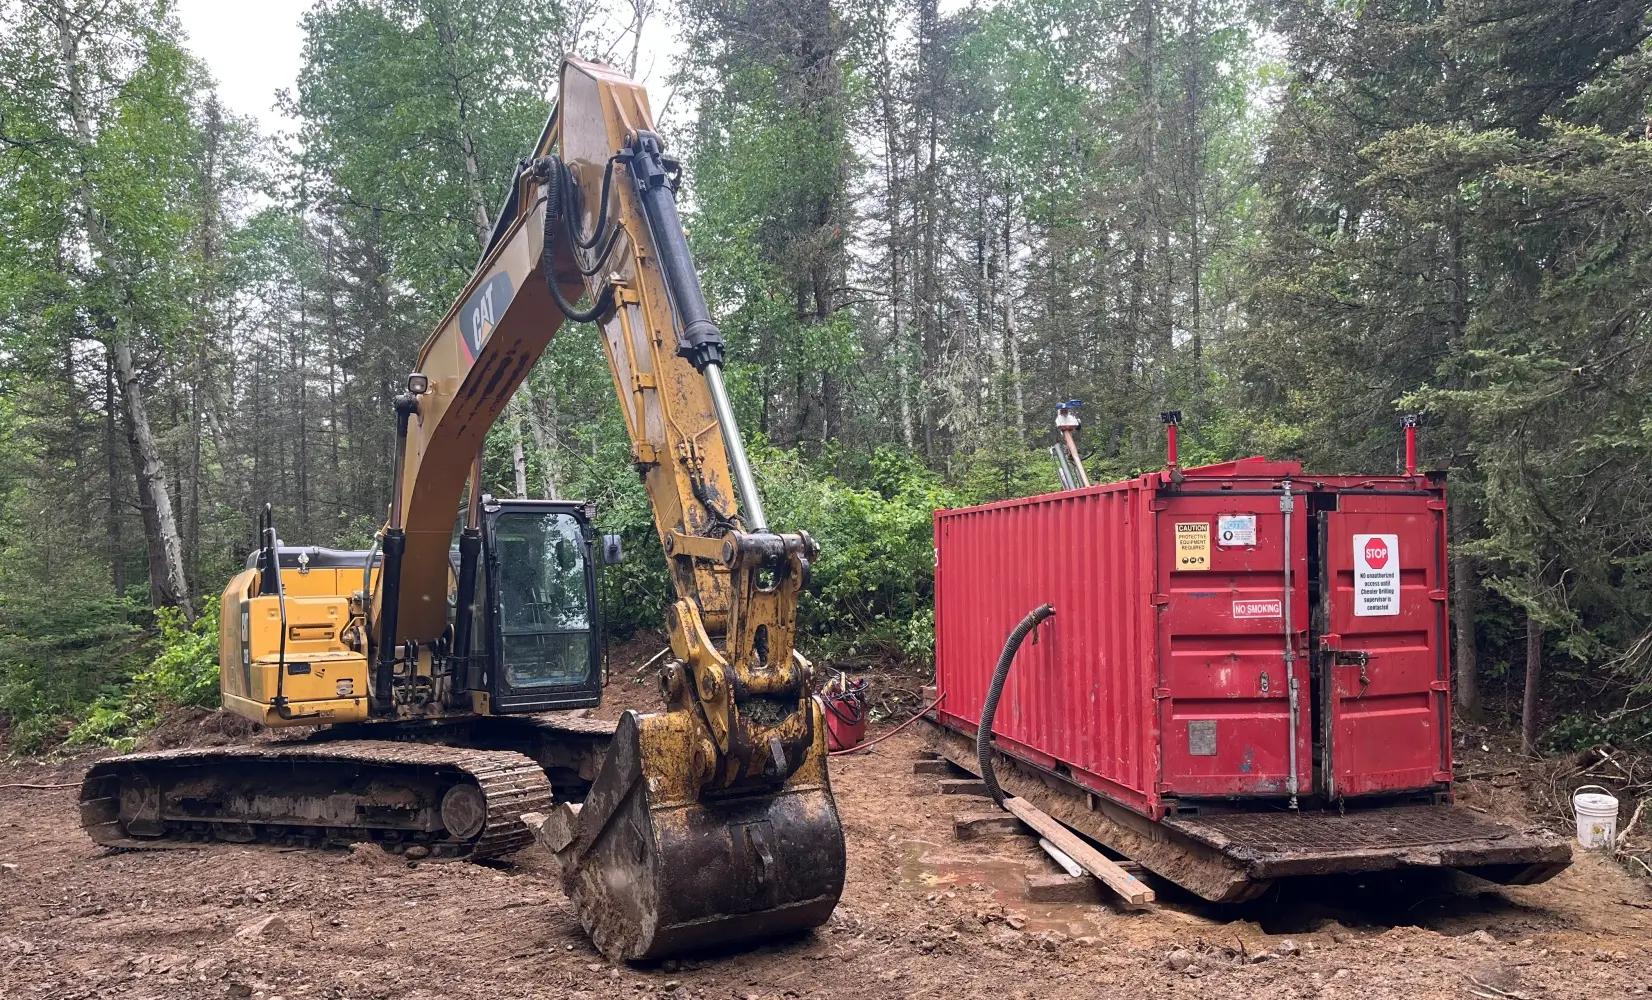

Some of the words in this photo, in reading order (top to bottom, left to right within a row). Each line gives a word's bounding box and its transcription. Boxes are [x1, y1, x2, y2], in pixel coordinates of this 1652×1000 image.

[473, 282, 494, 350] CAT
[1178, 524, 1207, 532] CAUTION
[1366, 548, 1387, 559] STOP
[1235, 604, 1246, 614] NO
[1247, 604, 1279, 613] SMOKING
